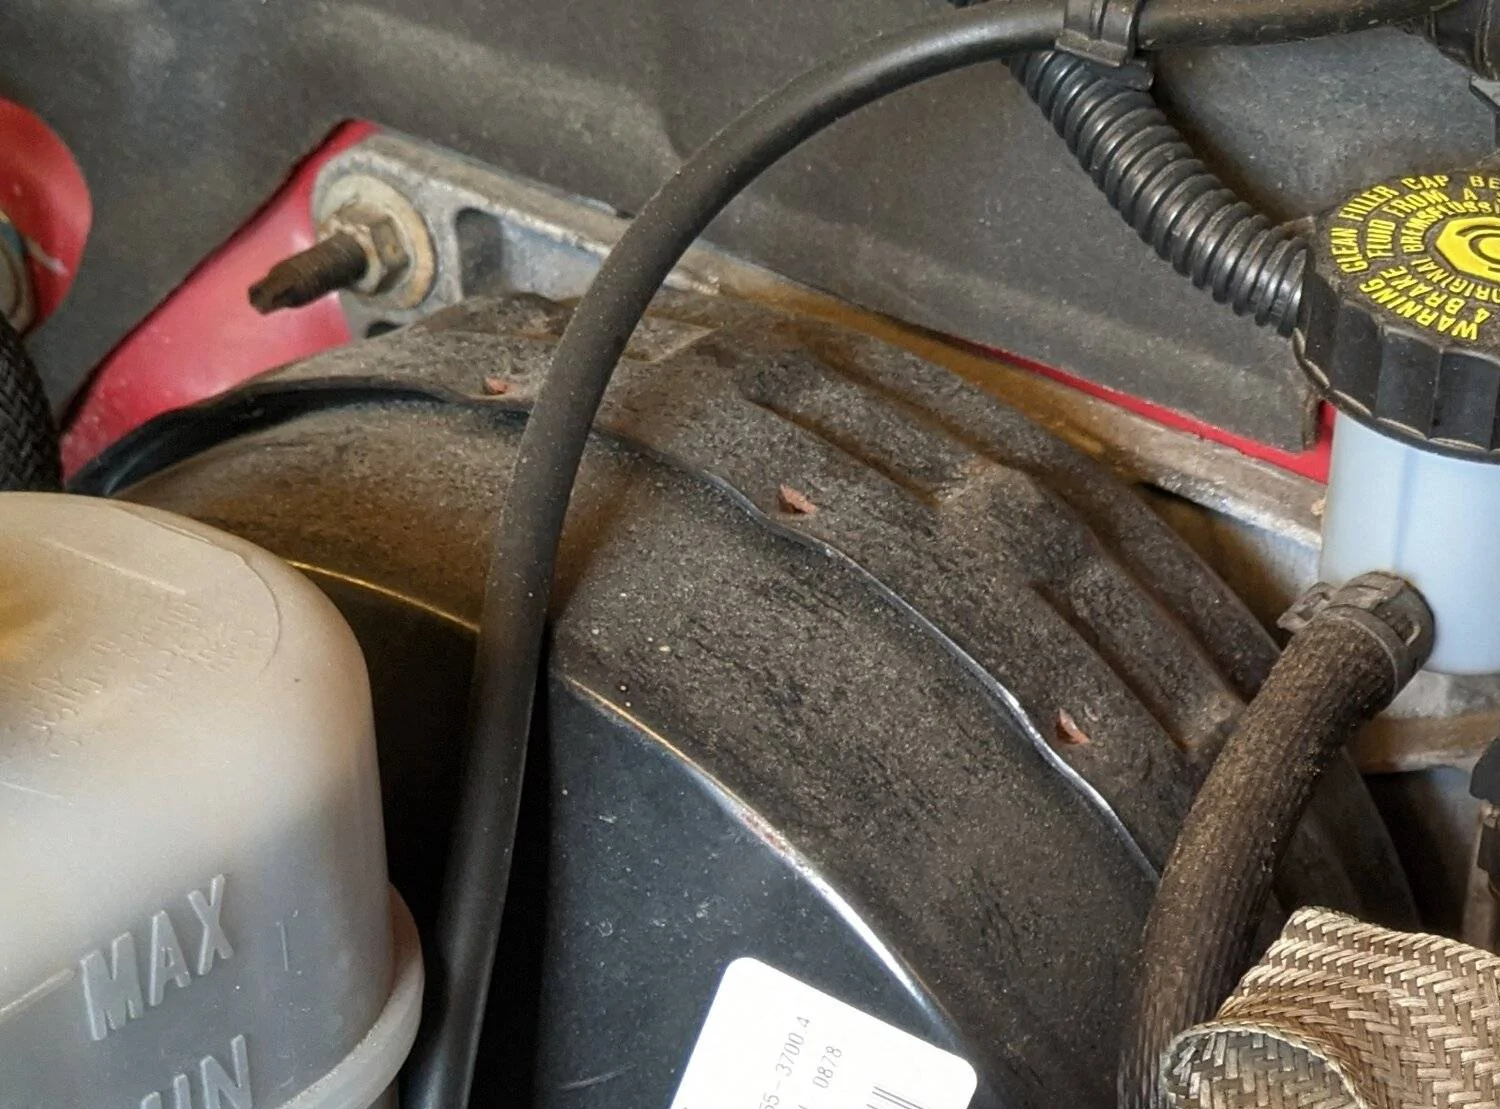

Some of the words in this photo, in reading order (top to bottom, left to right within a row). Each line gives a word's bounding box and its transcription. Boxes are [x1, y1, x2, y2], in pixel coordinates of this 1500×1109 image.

[1401, 175, 1450, 190] CAP
[1463, 187, 1478, 201] A
[1339, 185, 1400, 221] FILLER
[1382, 189, 1450, 218] FROM
[1331, 228, 1368, 273] CLEAN
[1366, 219, 1396, 258] FLUID
[1359, 278, 1478, 340] WARNING
[1380, 266, 1465, 315] BRAKE
[1474, 308, 1491, 323] 4
[80, 873, 235, 1041] MAX
[813, 1045, 842, 1089] 0878
